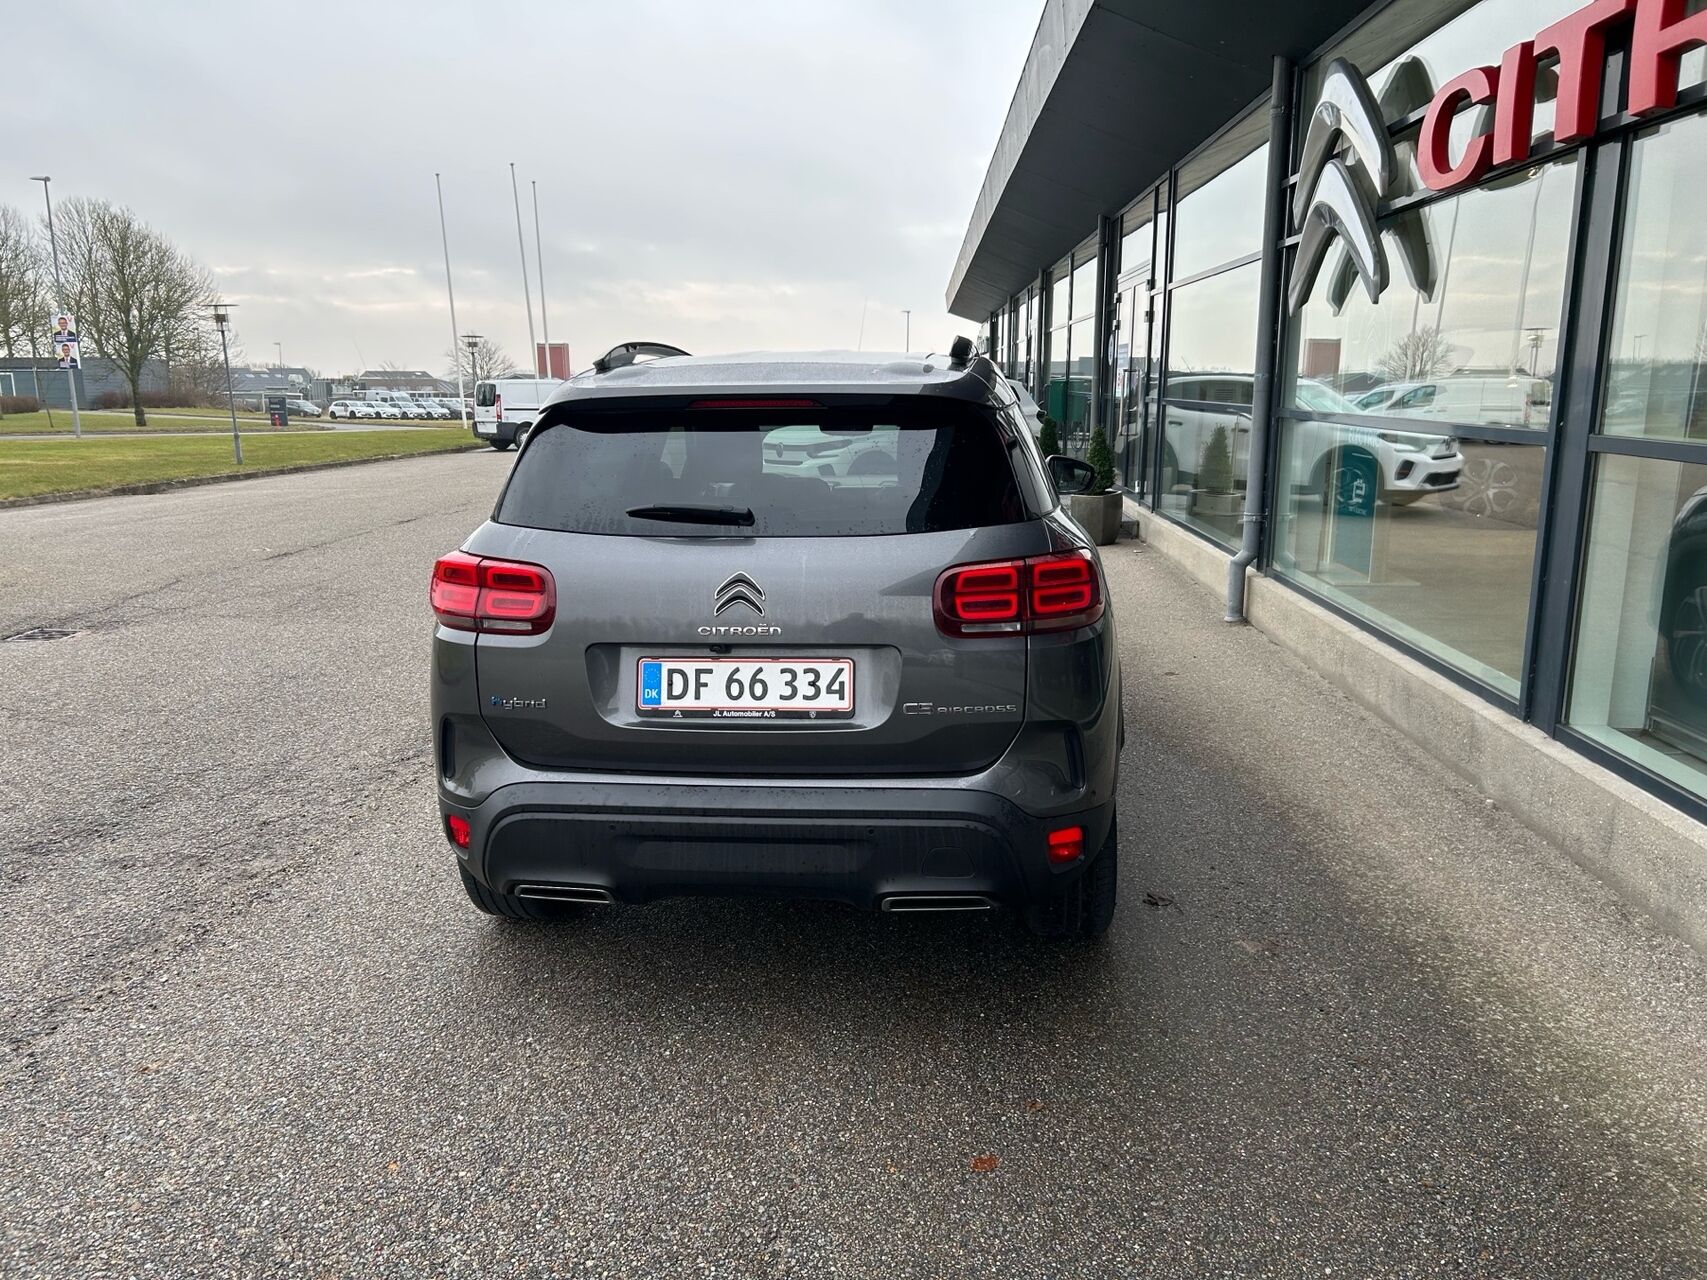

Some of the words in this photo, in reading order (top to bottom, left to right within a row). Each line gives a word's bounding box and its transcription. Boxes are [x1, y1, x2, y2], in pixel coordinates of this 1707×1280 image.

[666, 667, 714, 701] DF
[725, 666, 769, 701] 66
[779, 667, 846, 701] 334
[644, 688, 659, 699] DK
[902, 702, 934, 715] C5
[937, 704, 1017, 714] AIRCROSS
